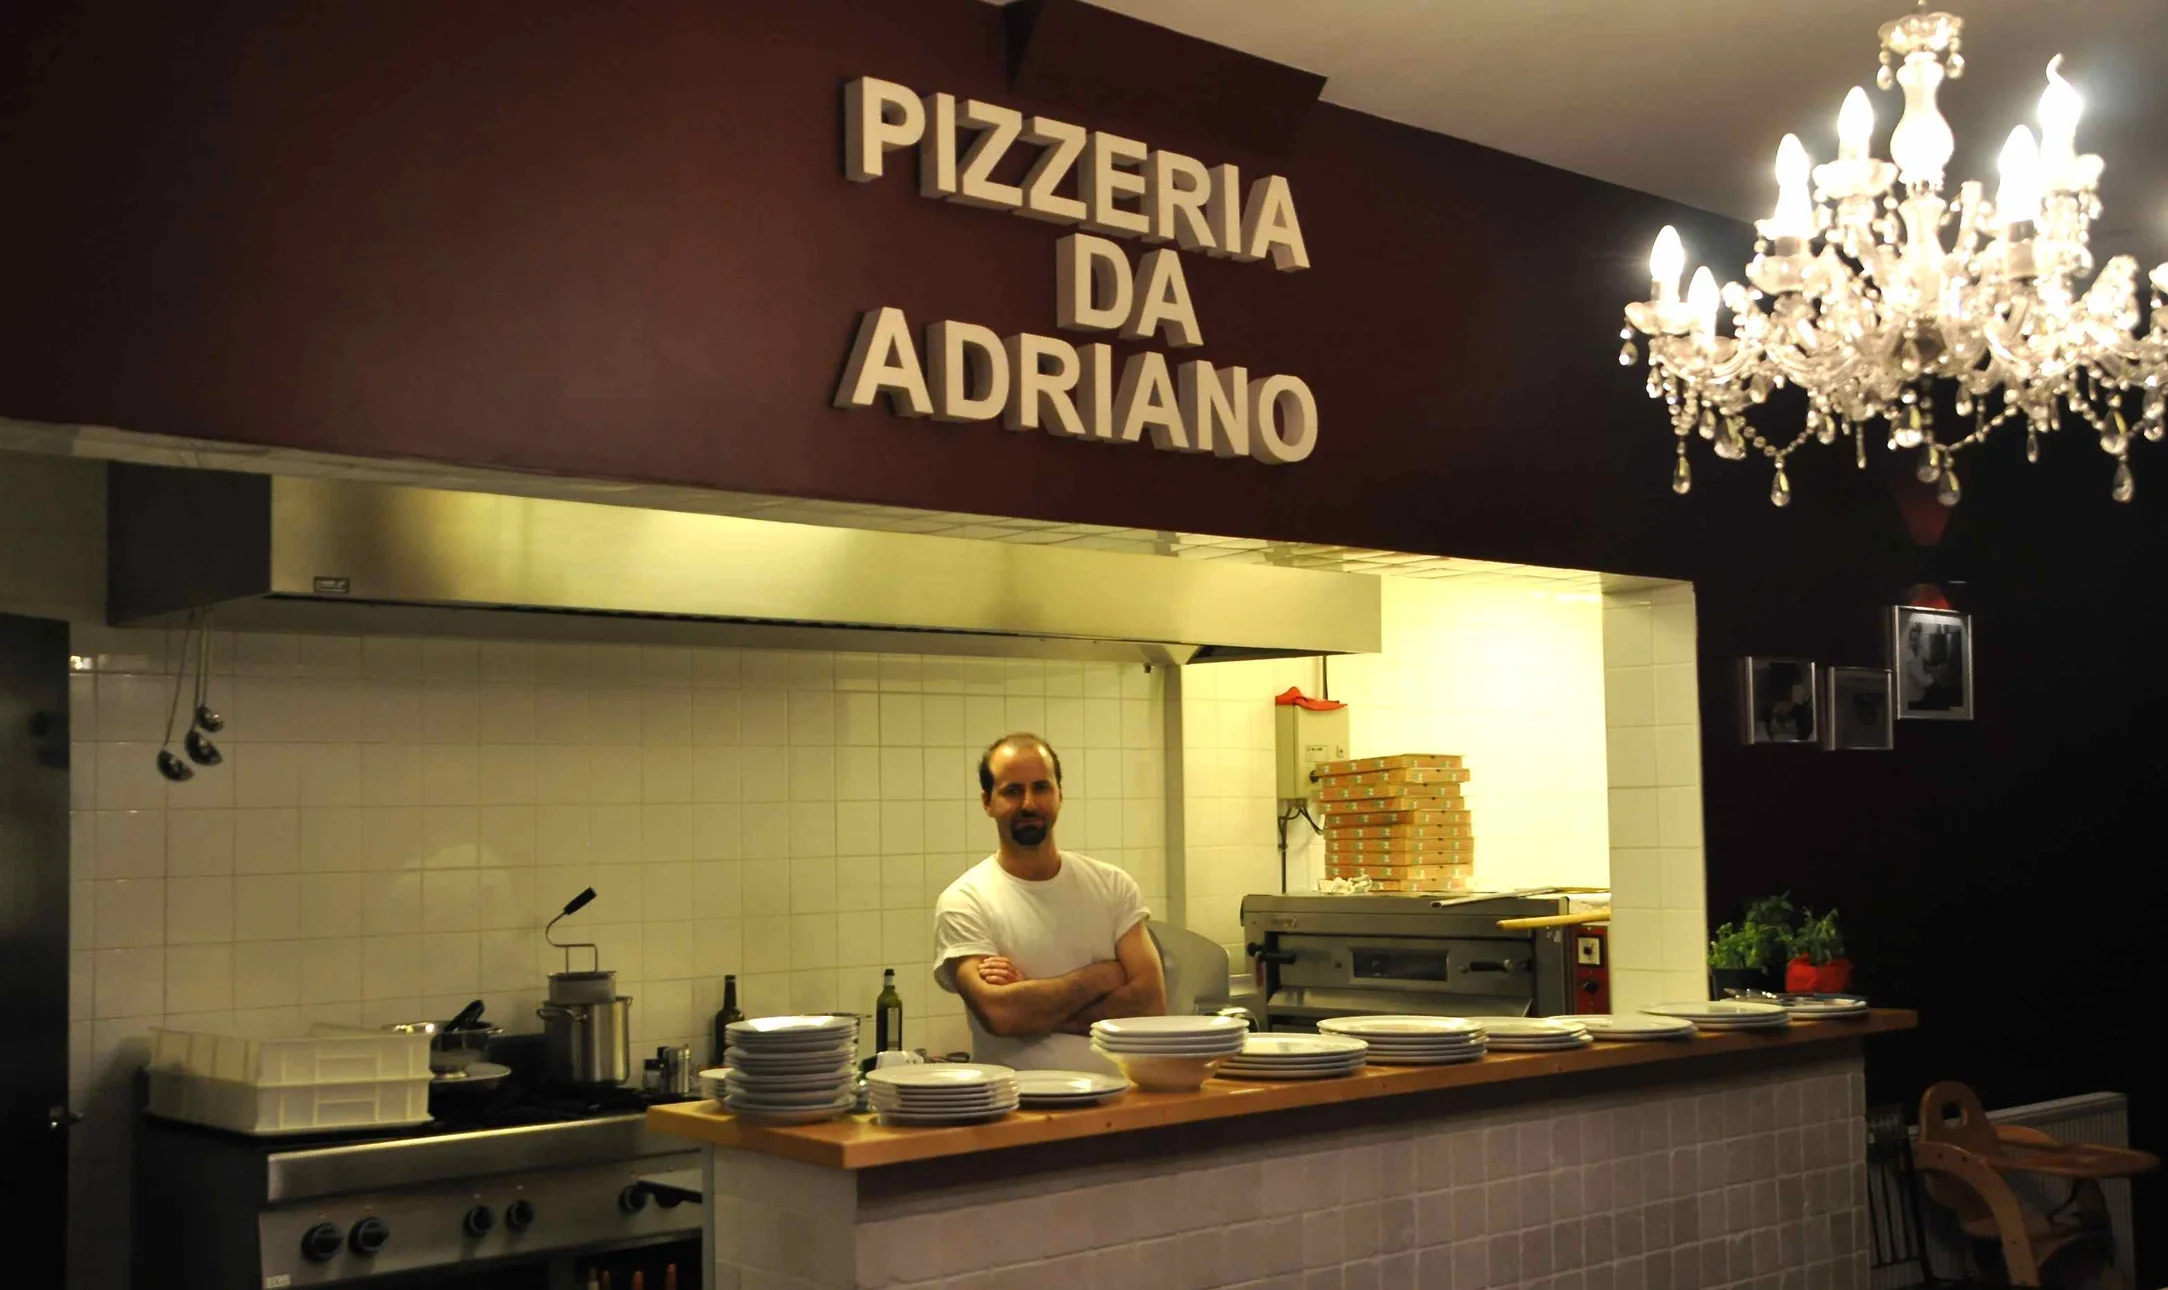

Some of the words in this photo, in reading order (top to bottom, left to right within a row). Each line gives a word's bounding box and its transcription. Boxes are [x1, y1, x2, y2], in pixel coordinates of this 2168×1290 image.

[847, 75, 1311, 270] PIZZERIA
[1057, 233, 1204, 347] DA
[836, 306, 1319, 464] ADRIANO
